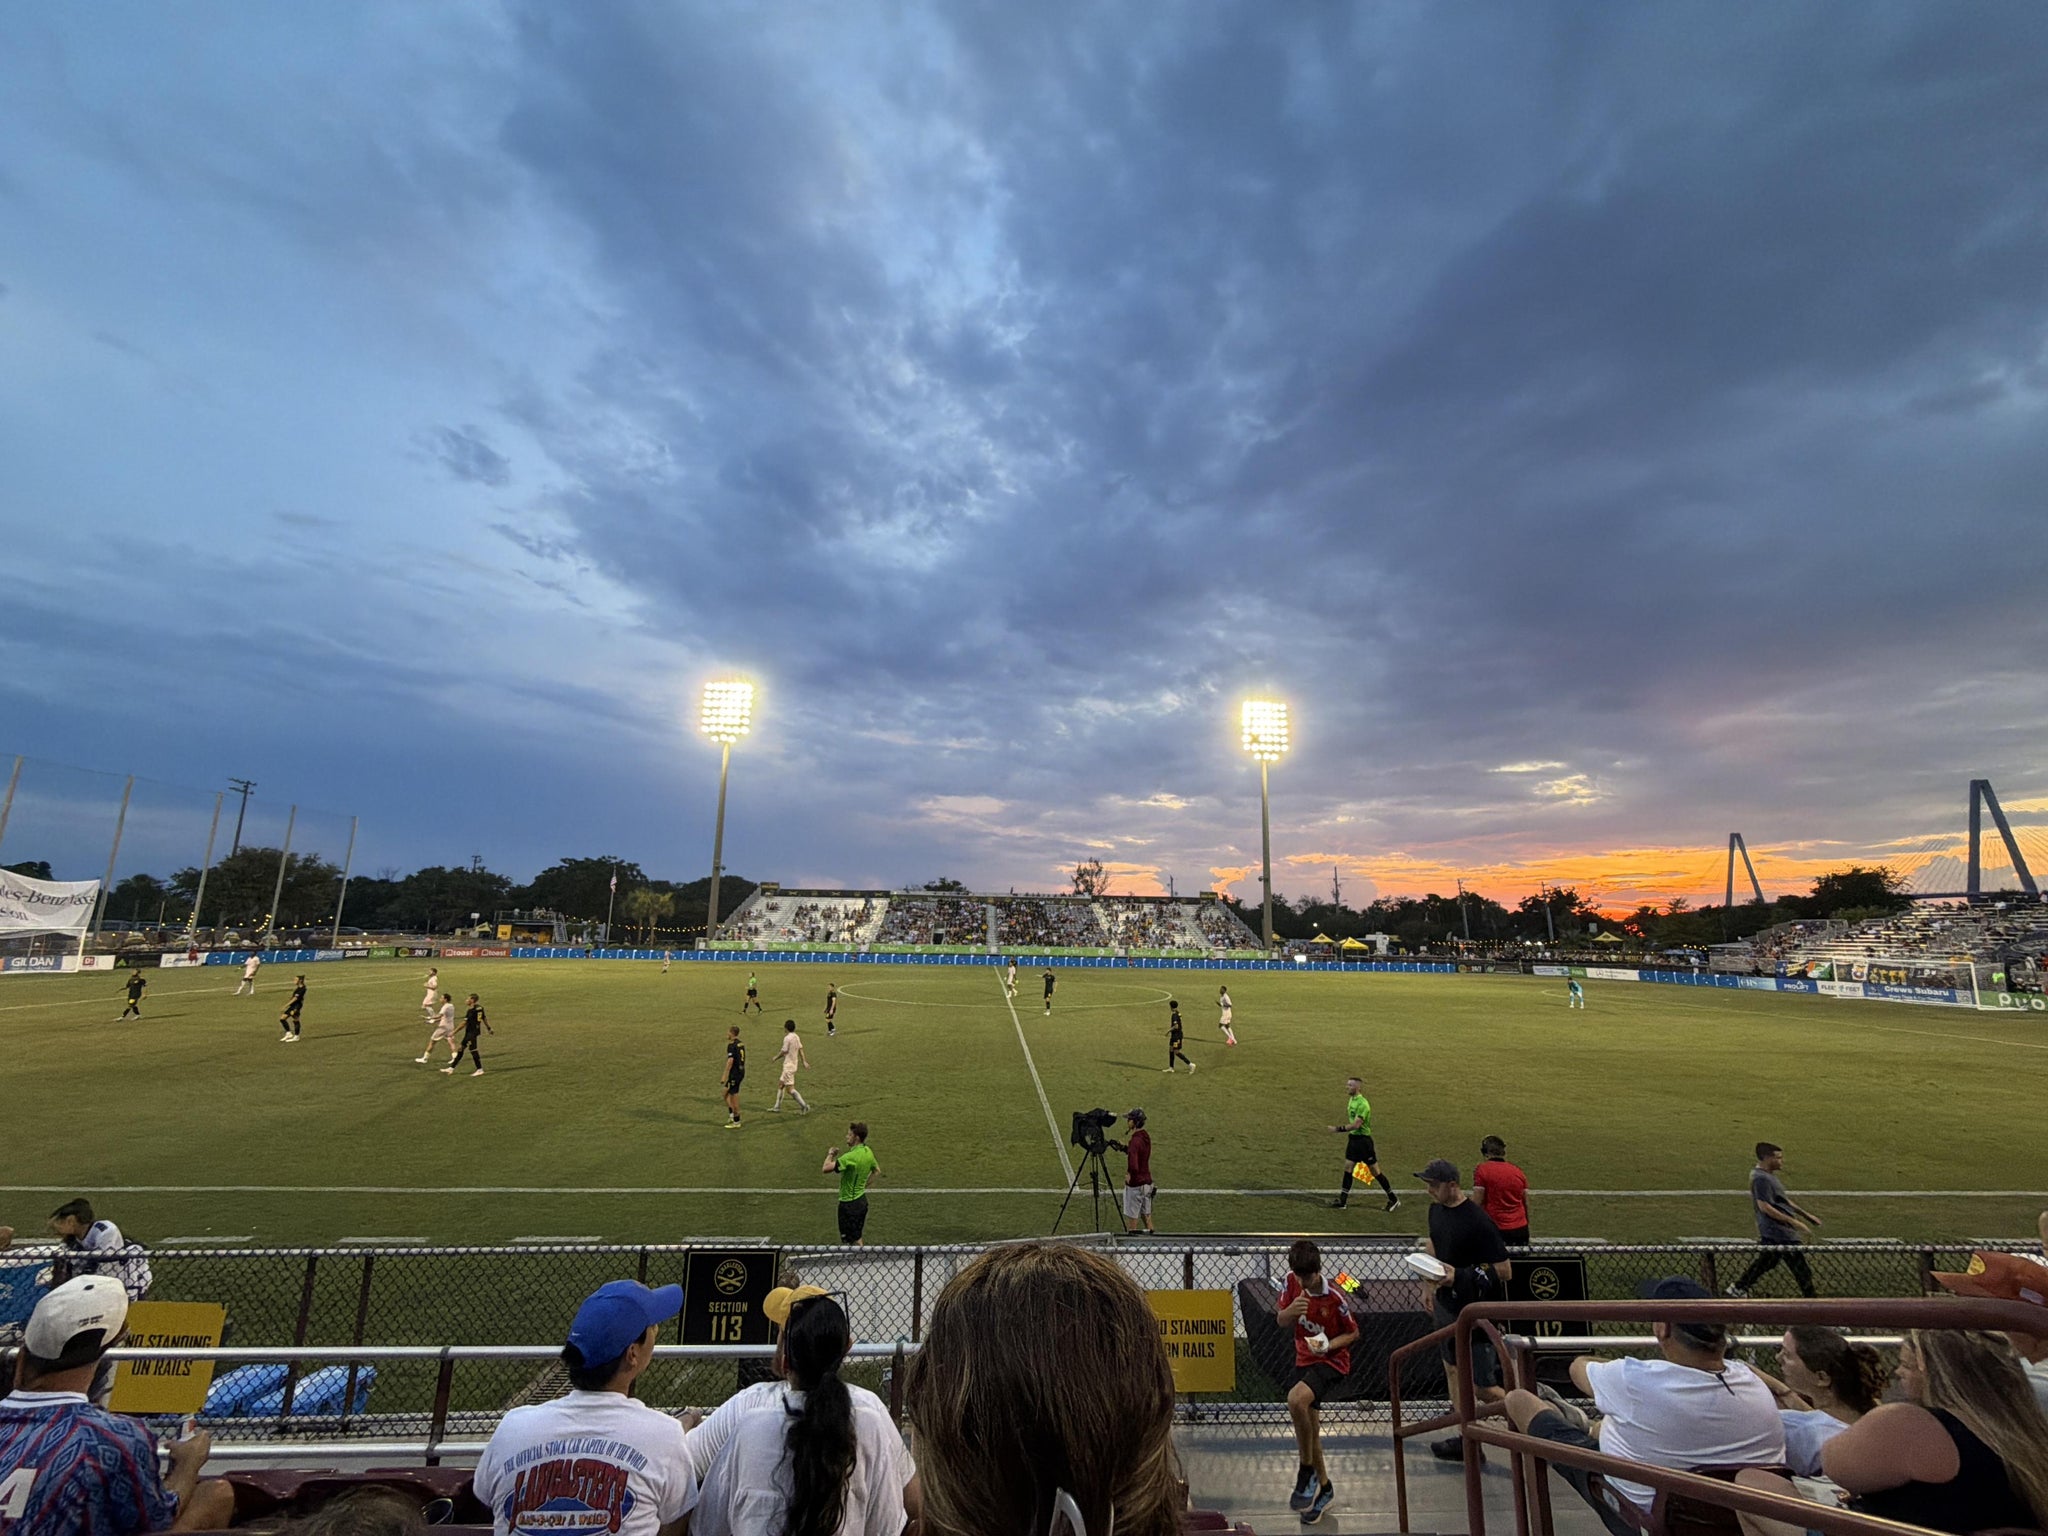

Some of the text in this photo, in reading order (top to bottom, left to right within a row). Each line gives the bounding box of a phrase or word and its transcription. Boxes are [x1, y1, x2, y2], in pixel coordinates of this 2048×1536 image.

[11, 956, 54, 967] GILDAN
[1884, 985, 1913, 994] Crews
[1914, 987, 1950, 996] Subaru
[708, 1301, 748, 1313] SECTION
[711, 1315, 743, 1341] 113
[1171, 1319, 1226, 1335] STANDING
[126, 1334, 212, 1348] NO STANDING
[1183, 1342, 1215, 1358] RAILS
[131, 1359, 193, 1376] ON RAILS
[503, 1455, 515, 1476] THE
[515, 1443, 543, 1468] OFFICIAL
[545, 1439, 567, 1457] STOCK
[567, 1438, 581, 1454] CAR
[581, 1438, 608, 1455] CAPITAL
[605, 1440, 619, 1457] OF
[625, 1447, 649, 1472] WORLD
